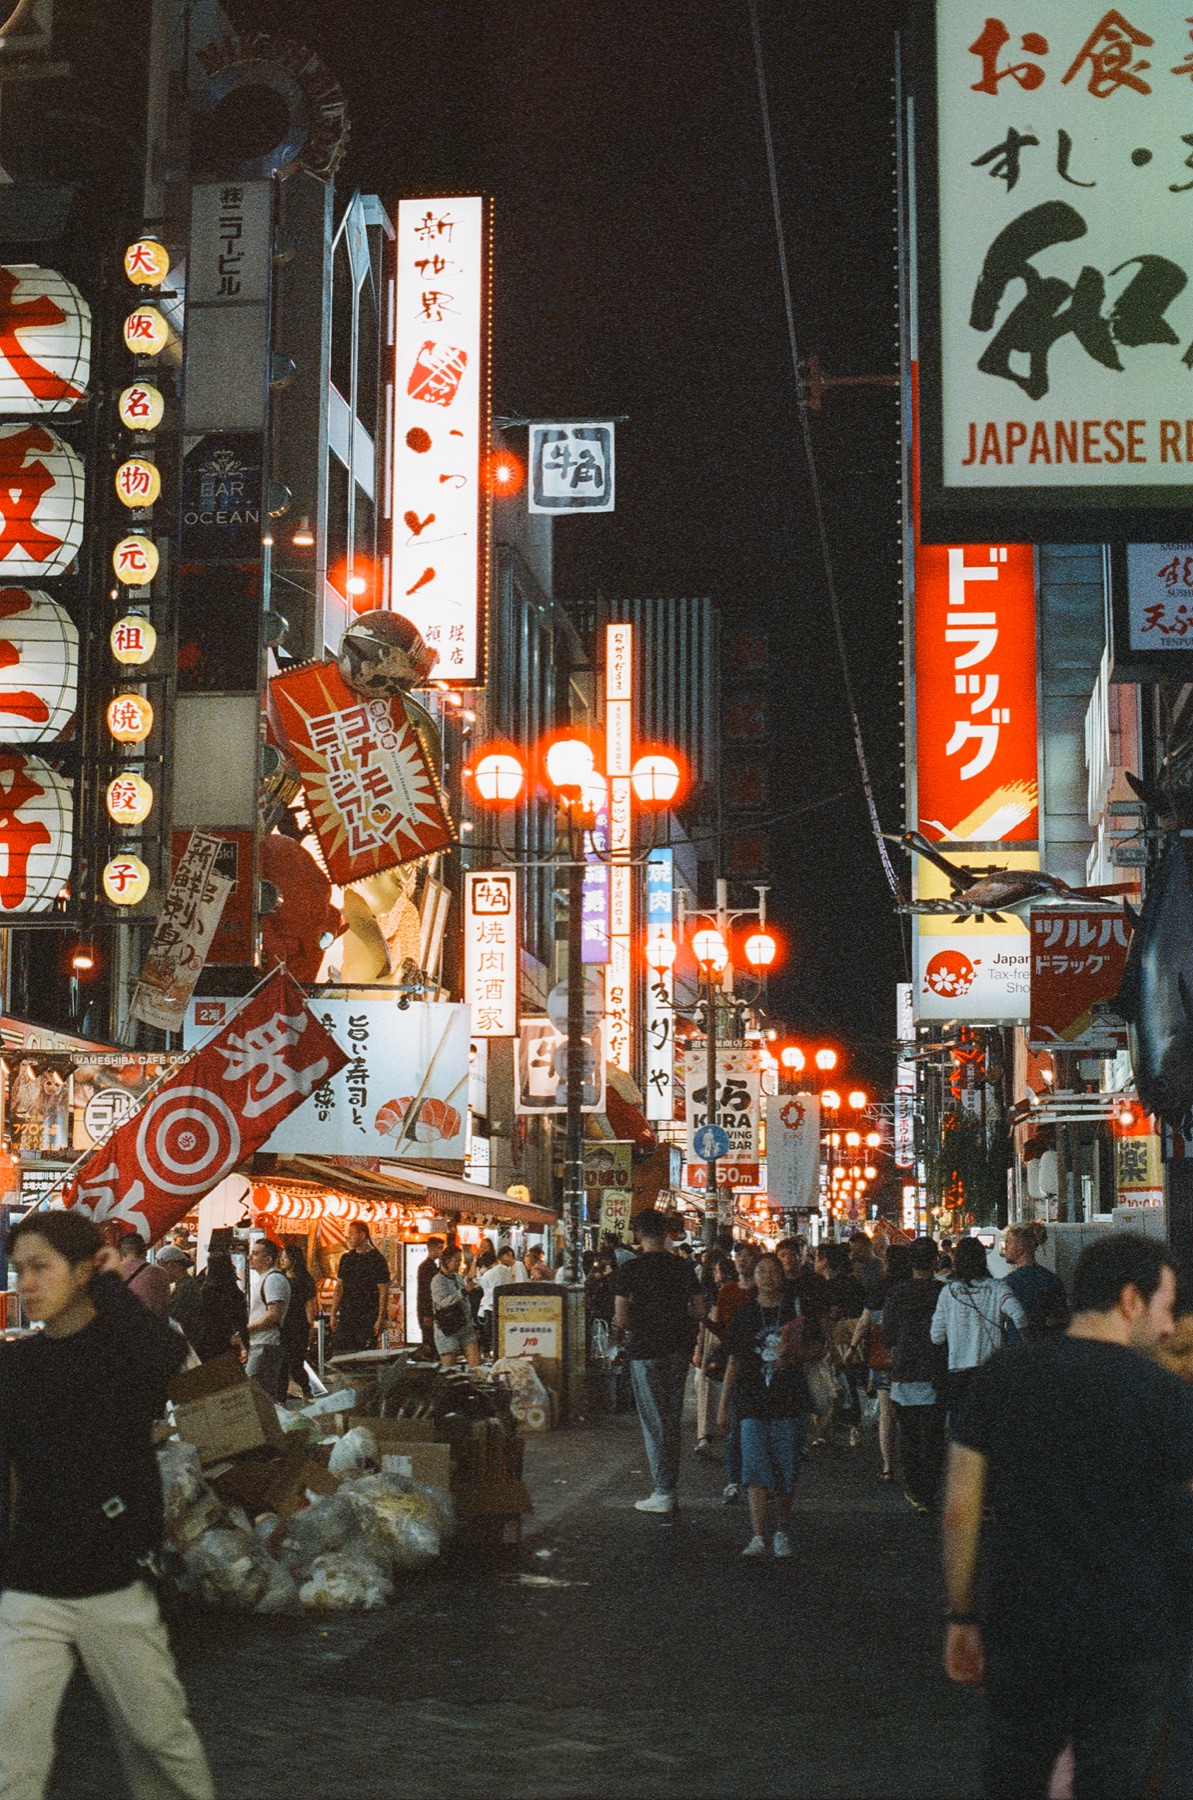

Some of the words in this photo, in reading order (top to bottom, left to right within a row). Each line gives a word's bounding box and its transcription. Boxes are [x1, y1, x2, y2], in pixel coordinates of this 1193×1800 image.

[414, 211, 466, 323] 新世界
[962, 420, 1147, 467] JAPANESE
[544, 444, 603, 489] 牛角
[201, 481, 244, 497] BAR
[184, 510, 260, 525] OCEAN
[945, 547, 1010, 781] ドラッグ
[478, 884, 507, 907] 牛角
[649, 861, 672, 912] 焼肉
[1035, 918, 1128, 948] ツルハ
[476, 920, 506, 1031] 焼肉酒家
[1035, 954, 1110, 975] ドラッグ
[199, 1008, 221, 1021] 2階
[76, 1056, 135, 1065] MAMESHIBA
[138, 1056, 166, 1064] CAFE
[346, 1014, 370, 1135] 旨い寿司と、
[728, 1141, 752, 1150] BAR
[1119, 1141, 1148, 1182] 薬
